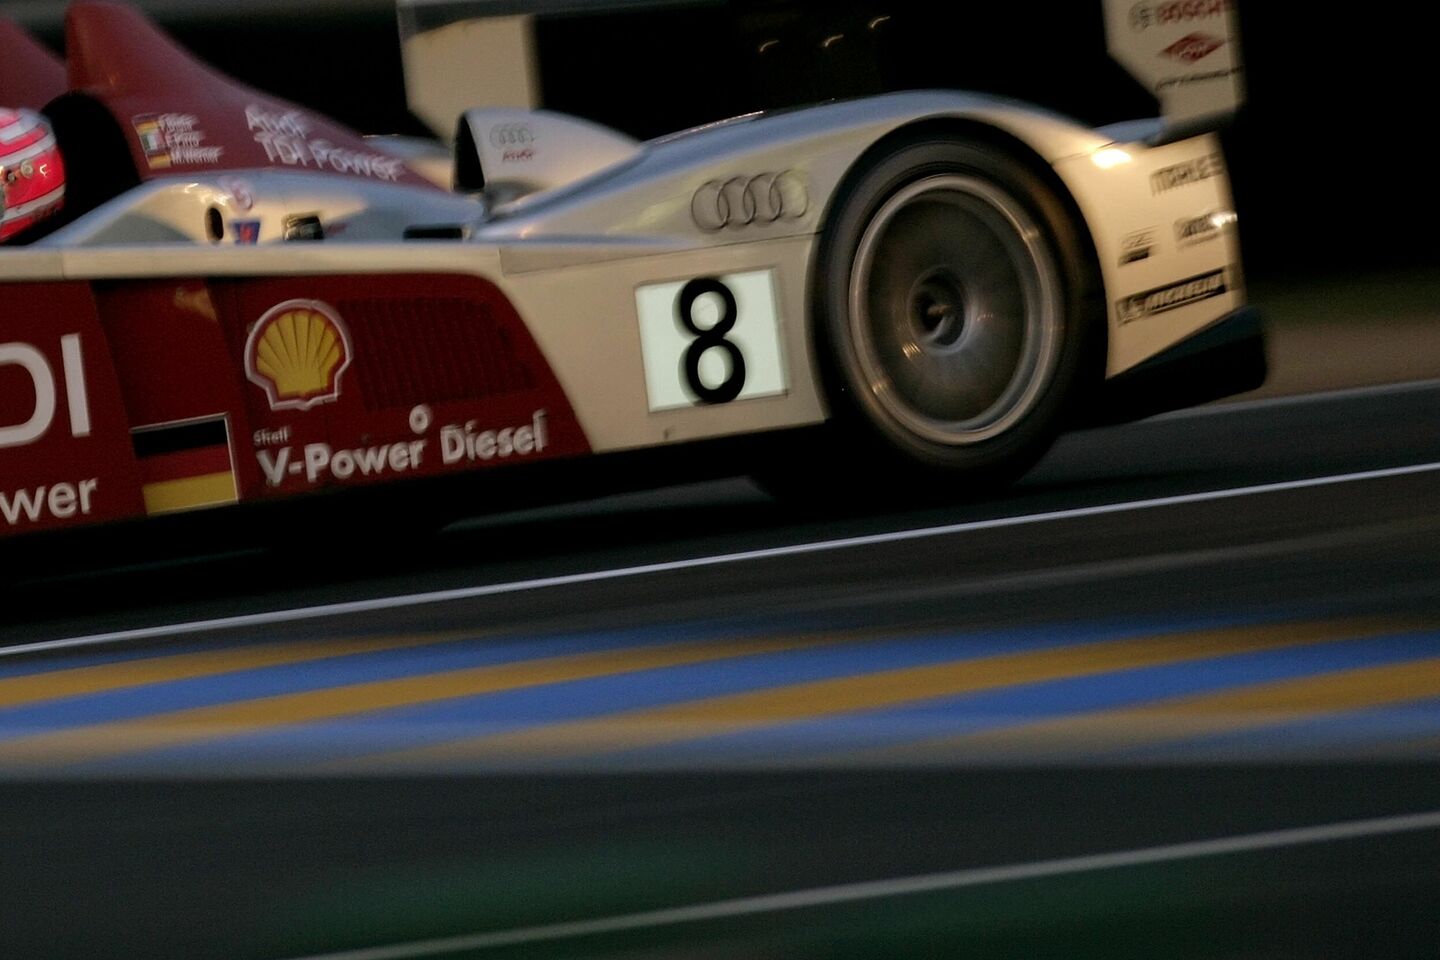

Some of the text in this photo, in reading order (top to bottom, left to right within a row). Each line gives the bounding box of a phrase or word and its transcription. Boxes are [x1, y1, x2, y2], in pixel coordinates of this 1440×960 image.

[253, 131, 401, 182] TDI Power
[672, 275, 746, 406] 8
[256, 408, 549, 487] V-Power Diesel
